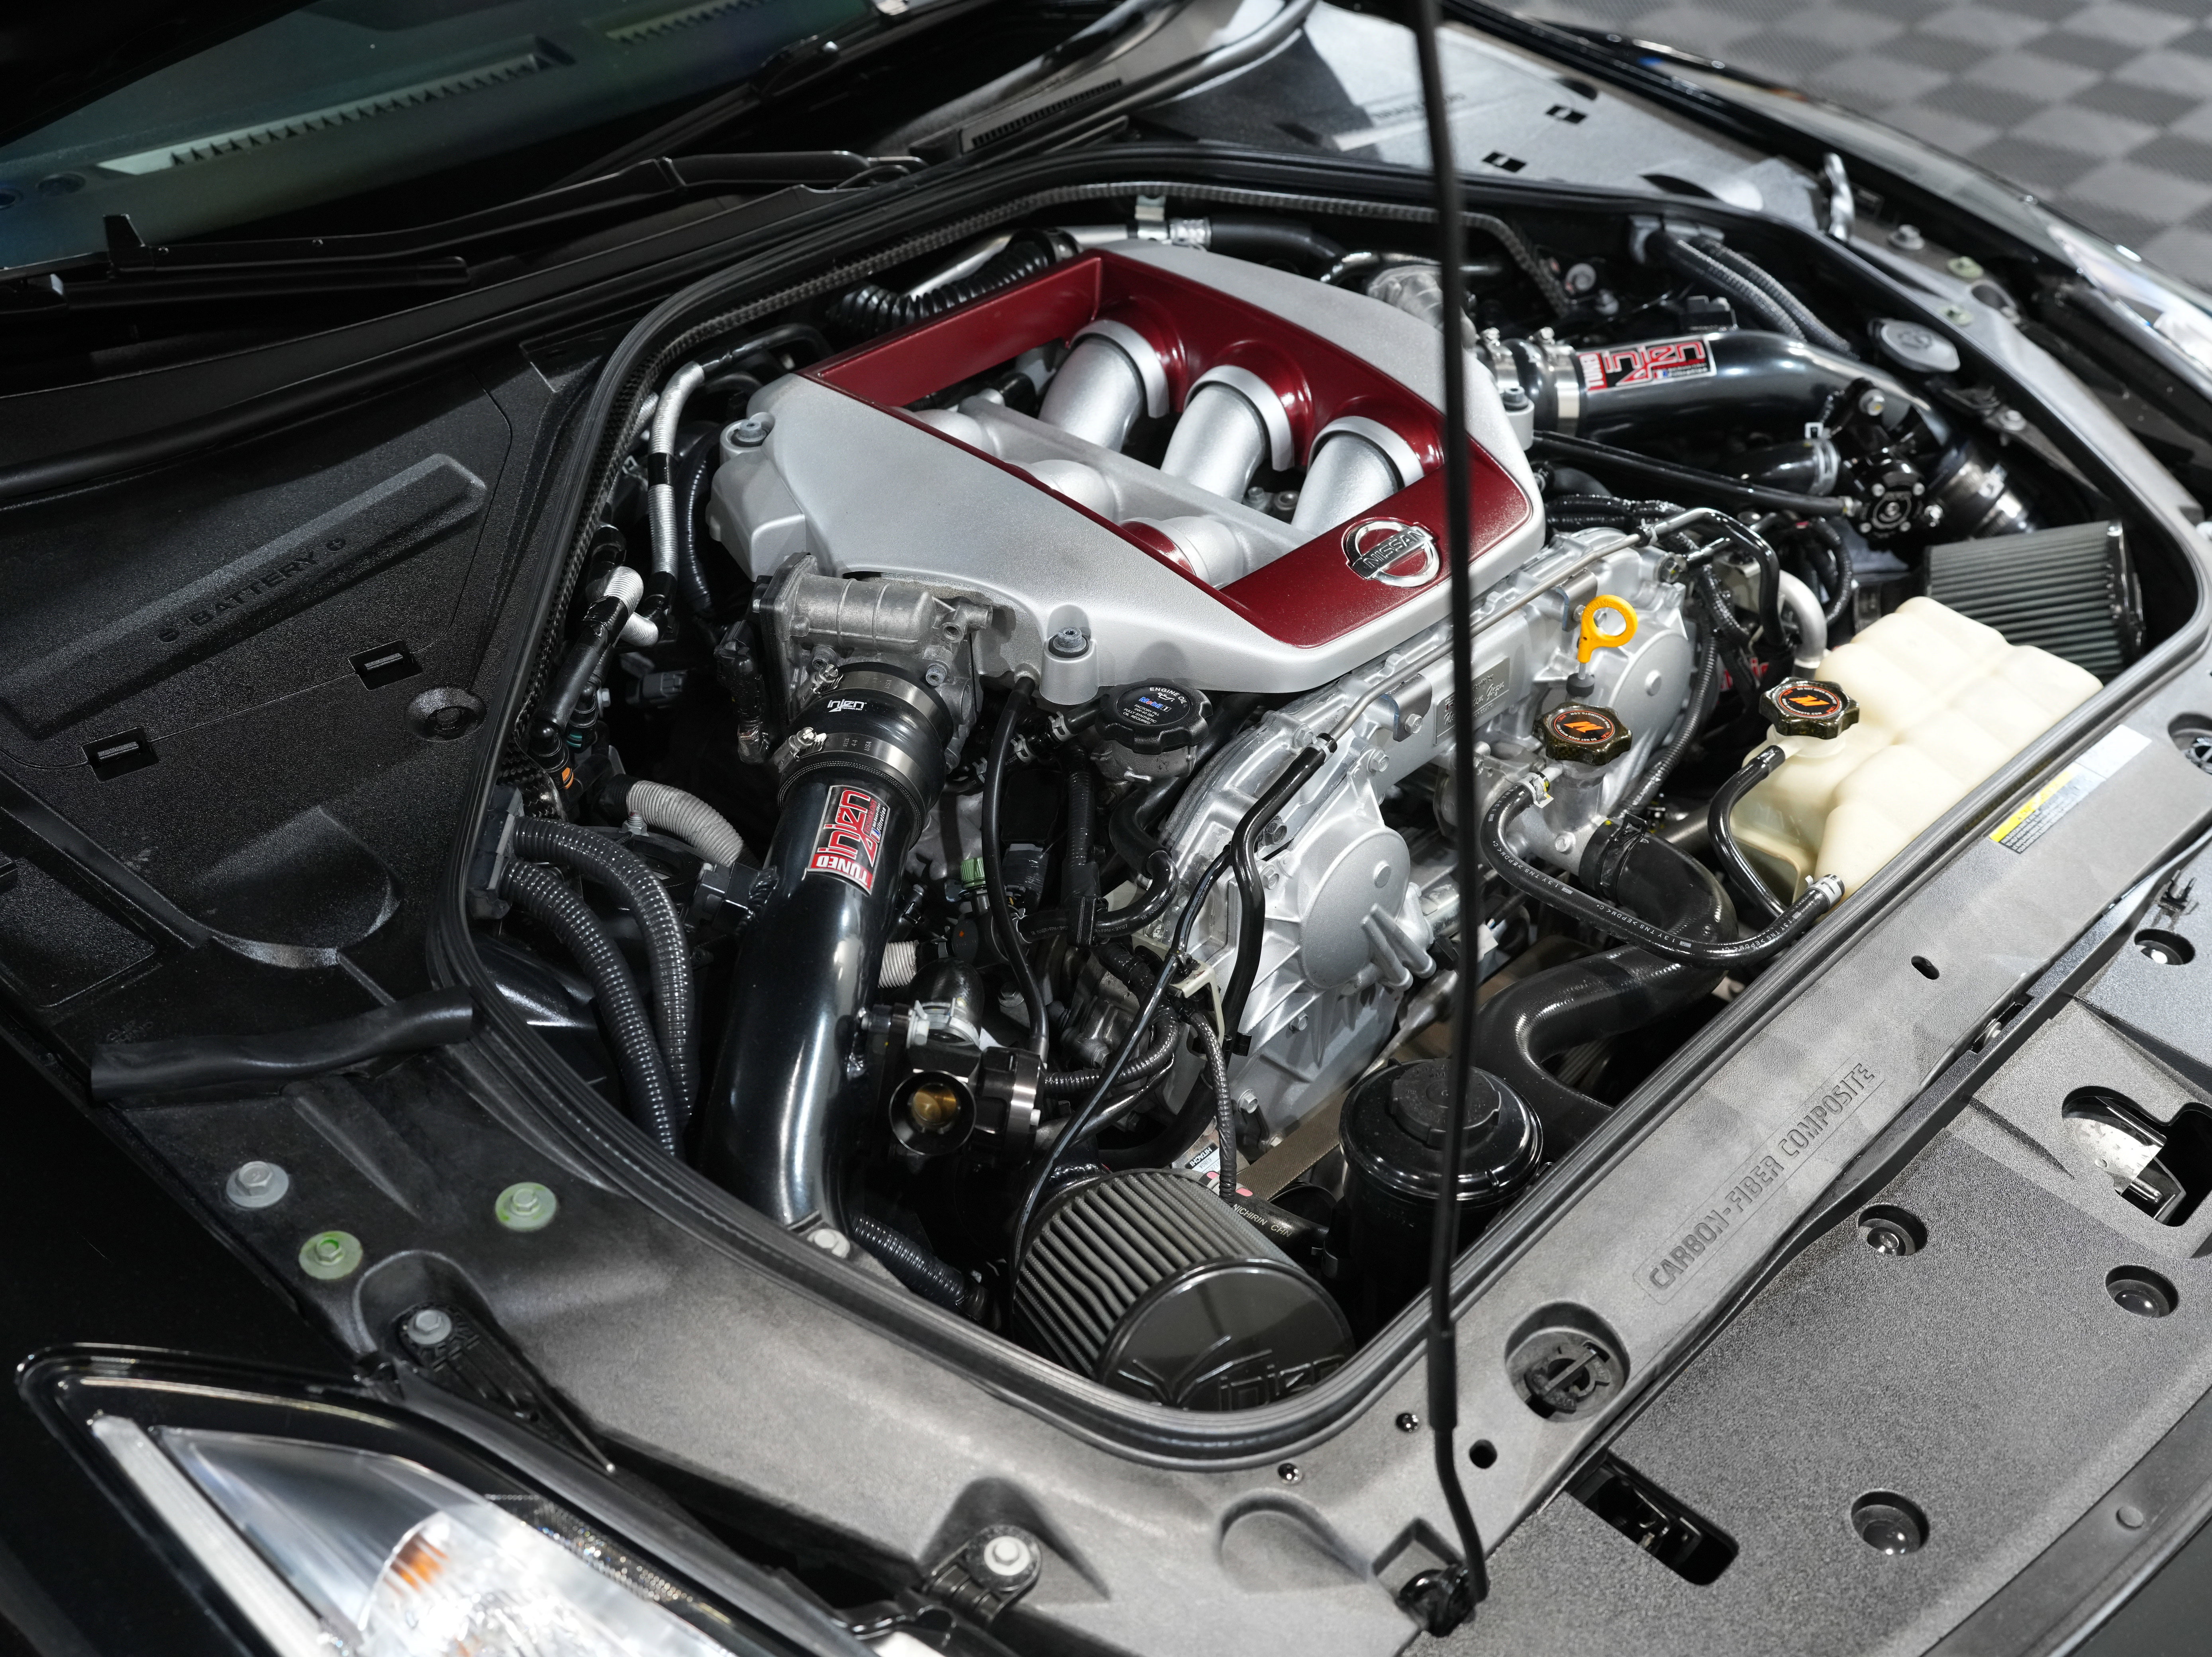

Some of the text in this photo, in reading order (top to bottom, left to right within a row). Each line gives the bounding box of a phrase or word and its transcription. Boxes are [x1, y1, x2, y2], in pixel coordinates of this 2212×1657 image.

[1363, 529, 1426, 568] NISSAN
[188, 551, 317, 627] BATTERY
[1139, 697, 1163, 709] Mobil
[1149, 687, 1180, 697] ENGINE
[827, 699, 865, 712] injen
[1134, 704, 1153, 713] FACTORY
[1131, 715, 1151, 725] REQUIRED
[1135, 713, 1157, 723] SYNTHETIC
[817, 790, 878, 868] injen
[877, 807, 886, 833] Filtration
[816, 855, 867, 886] TUNED
[1190, 1147, 1213, 1167] HITACHI
[1649, 1063, 1875, 1289] CARBON-FIBER COMPOSITE
[1233, 1204, 1292, 1237] NICHIRIN CHN
